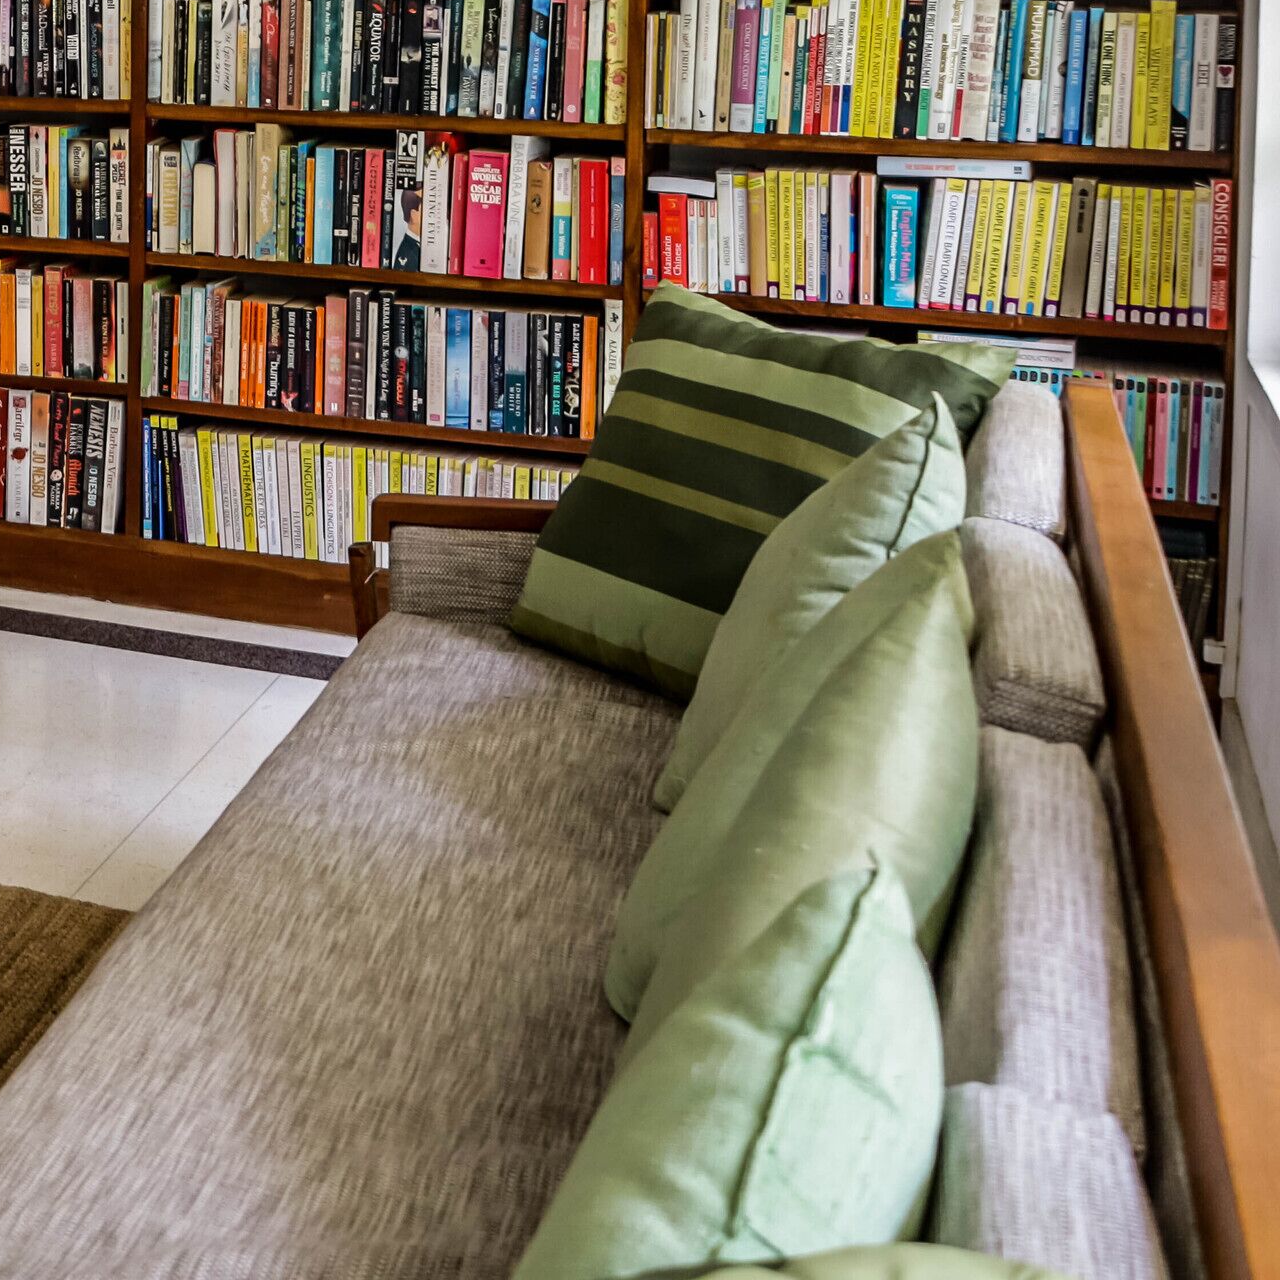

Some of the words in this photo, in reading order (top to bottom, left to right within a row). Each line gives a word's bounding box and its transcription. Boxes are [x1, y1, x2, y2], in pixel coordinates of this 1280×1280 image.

[370, 11, 382, 62] EQUATOR
[1028, 5, 1043, 77] MUHAMMAD
[10, 134, 26, 192] NESSER
[470, 172, 502, 182] WORKS
[513, 143, 524, 188] BARBARA
[470, 184, 502, 194] OSCAR
[470, 194, 501, 204] WILDE
[512, 190, 522, 225] VINE
[1213, 183, 1227, 267] CONSIGLIERI
[674, 243, 682, 276] Chinese
[242, 450, 252, 518] MATHEMATICS
